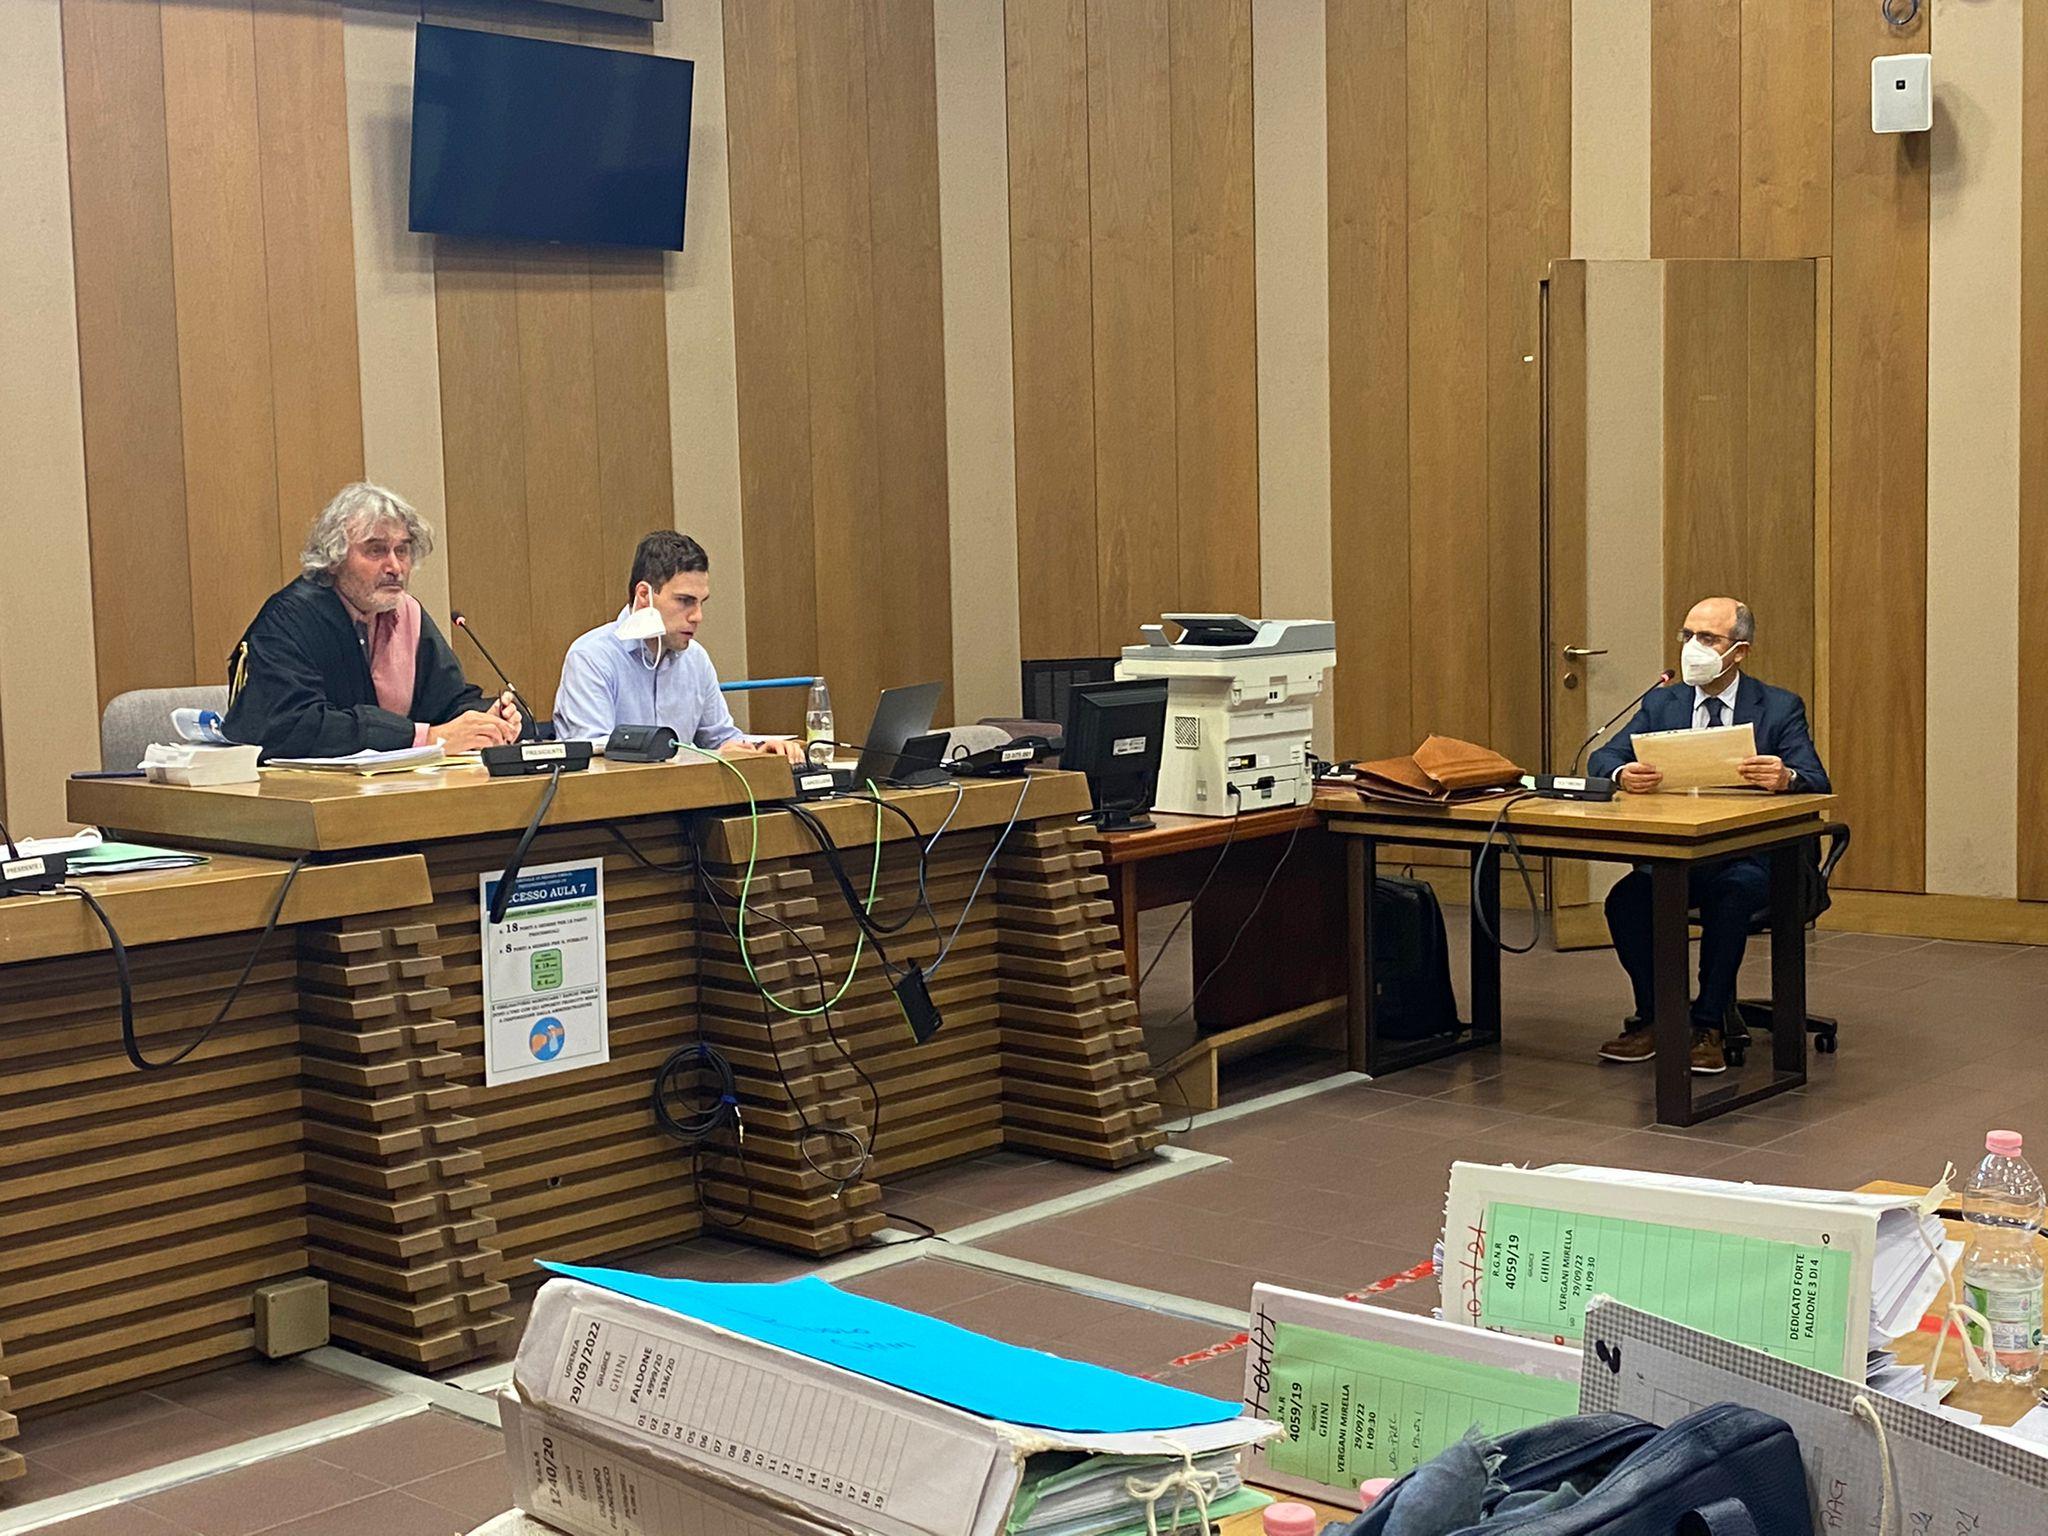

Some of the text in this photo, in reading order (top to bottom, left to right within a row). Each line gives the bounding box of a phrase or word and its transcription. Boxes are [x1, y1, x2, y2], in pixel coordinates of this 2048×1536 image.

[509, 889, 548, 904] CESSO
[550, 884, 578, 898] AULA
[580, 883, 587, 893] 7
[506, 922, 519, 933] 18
[505, 943, 512, 953] 8
[1492, 1242, 1502, 1277] R.G.N.R
[1505, 1234, 1520, 1290] 4059/19
[1540, 1250, 1551, 1283] GHINI
[1559, 1229, 1573, 1311] VERGANI MIRELLA
[1586, 1256, 1596, 1283] 09:30
[1572, 1254, 1583, 1297] 29/09/22
[1809, 1268, 1818, 1279] DI
[1790, 1253, 1805, 1340] DEDICATO FORTE
[1805, 1289, 1817, 1339] FALDONE
[564, 1339, 580, 1378] UDIENZA
[569, 1321, 600, 1404] 29/09/2022
[597, 1350, 611, 1387] GIUDICE
[609, 1354, 628, 1392] GHINI
[630, 1346, 653, 1404] FALDONE
[649, 1358, 675, 1431] 02 1936/20
[638, 1414, 646, 1426] 01
[1289, 1382, 1303, 1443] 4059/19
[1319, 1402, 1329, 1438] GHINI
[661, 1422, 671, 1435] 03
[674, 1426, 683, 1439] 04
[686, 1431, 696, 1443] 05
[1337, 1384, 1350, 1473] VERGANI MIRELLA
[1354, 1403, 1365, 1450] 29/09/22
[1366, 1411, 1376, 1450] H 09:30
[699, 1435, 709, 1448] 06
[713, 1440, 722, 1453] 07
[728, 1444, 737, 1458] 08
[742, 1449, 751, 1463] 09
[755, 1453, 764, 1466] 10
[768, 1459, 777, 1471] 11
[542, 1437, 562, 1507] 1240/20
[781, 1463, 790, 1475] 12
[794, 1467, 804, 1480] 13
[807, 1472, 817, 1485] 14
[821, 1477, 830, 1489] 15
[834, 1481, 843, 1494] 16
[847, 1486, 856, 1499] 17
[602, 1465, 617, 1530] FRANCESCO
[861, 1490, 871, 1504] 18
[874, 1495, 884, 1509] 19
